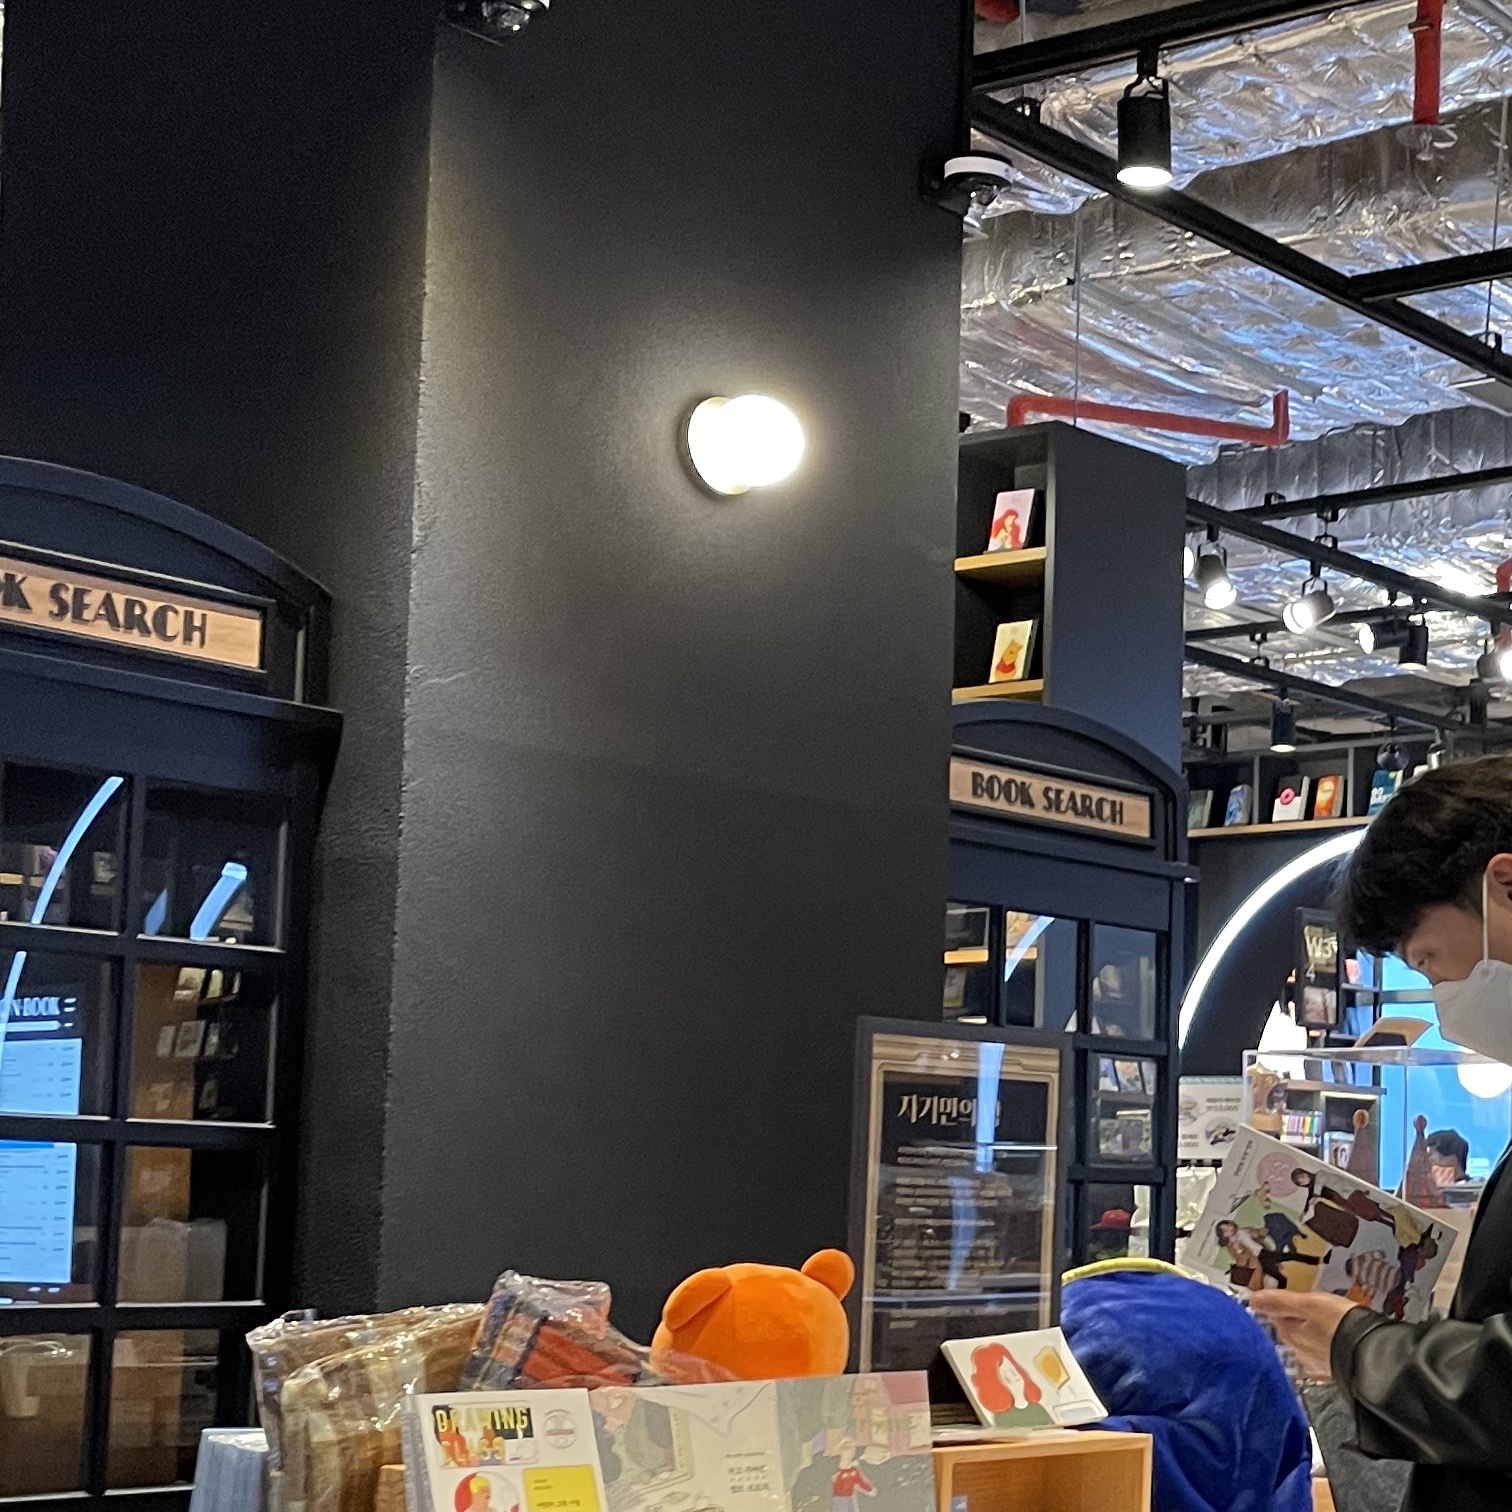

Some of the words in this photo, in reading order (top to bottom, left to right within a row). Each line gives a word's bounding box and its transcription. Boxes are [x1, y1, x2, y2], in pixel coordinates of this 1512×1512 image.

[0, 572, 32, 612] K
[49, 582, 207, 649] SEARCH
[971, 771, 1035, 809] BOOK
[1042, 786, 1124, 825] SEARCH
